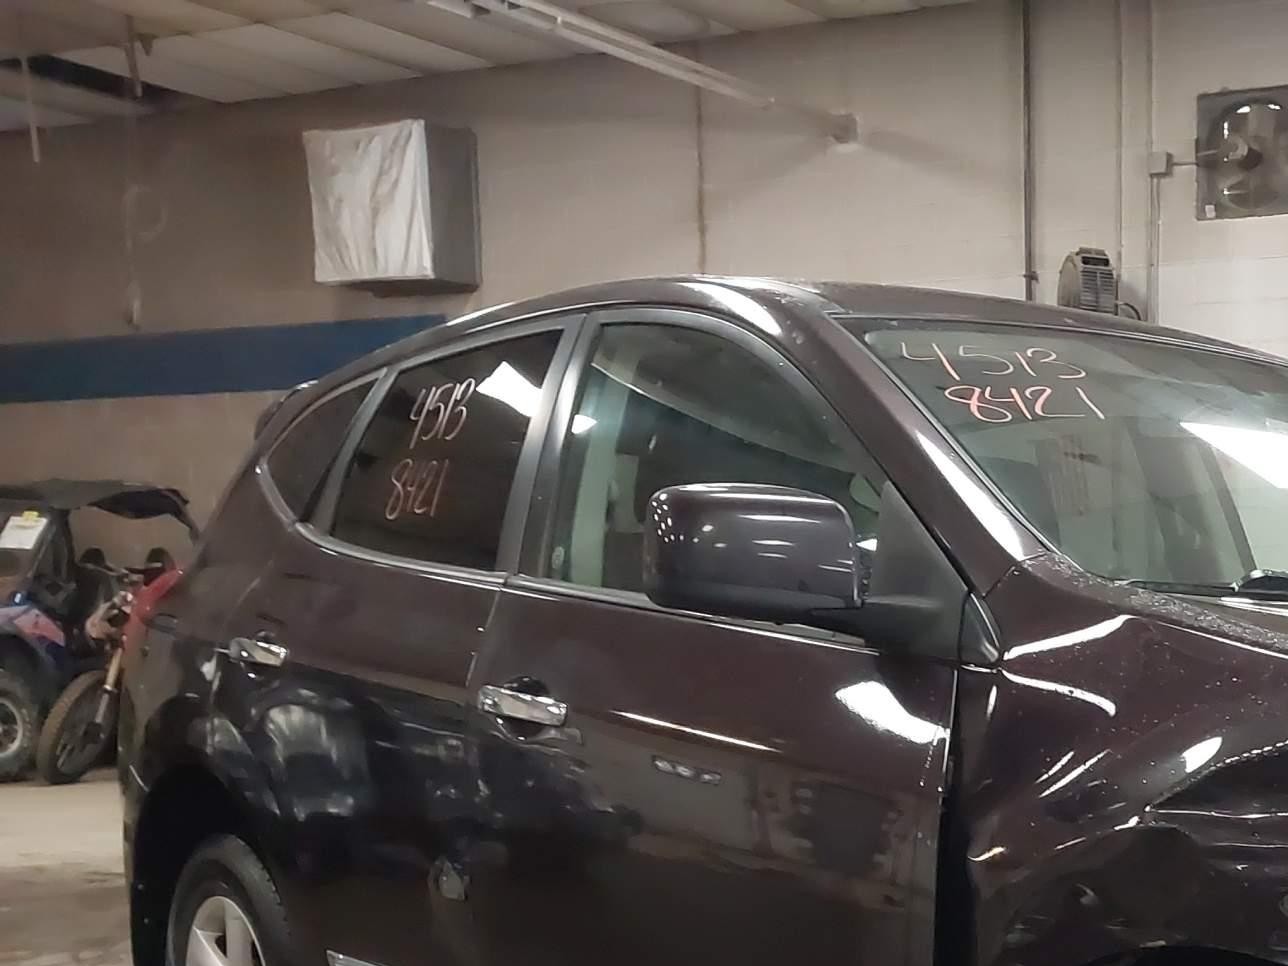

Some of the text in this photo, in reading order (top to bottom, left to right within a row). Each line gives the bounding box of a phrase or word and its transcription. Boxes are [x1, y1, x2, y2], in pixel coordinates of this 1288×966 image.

[901, 341, 1087, 381] 4513
[409, 377, 476, 450] 4513
[944, 385, 1105, 424] 8421
[385, 458, 450, 521] 8421
